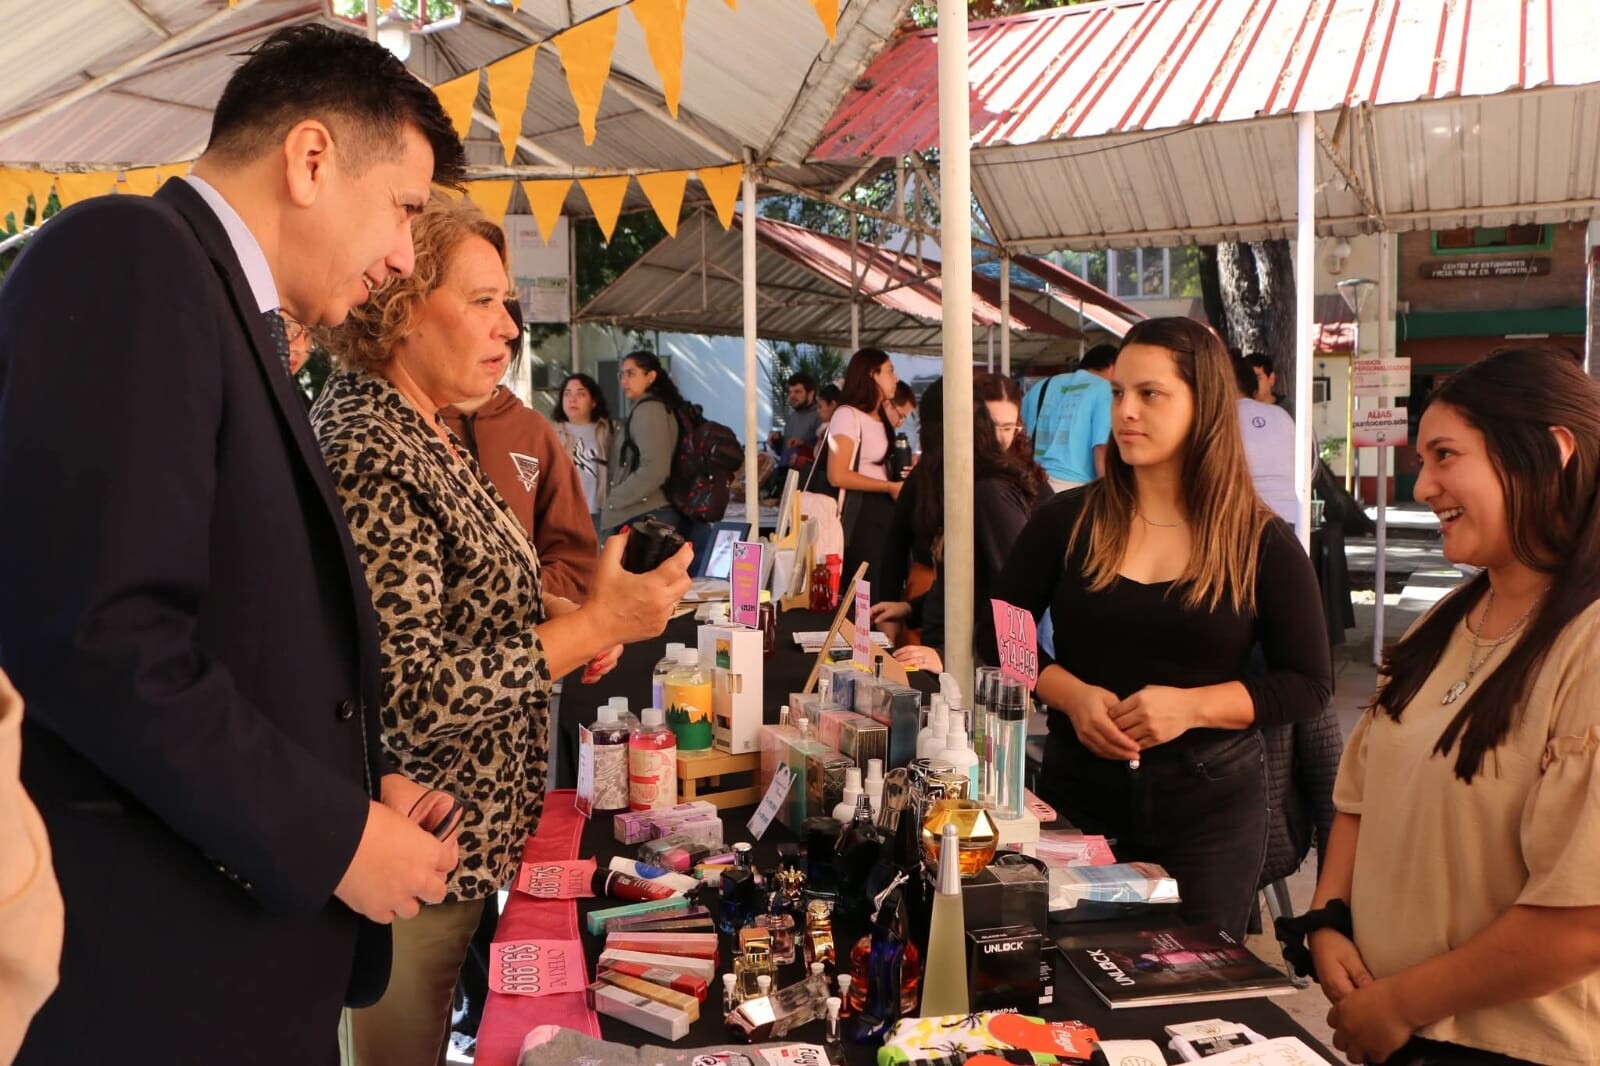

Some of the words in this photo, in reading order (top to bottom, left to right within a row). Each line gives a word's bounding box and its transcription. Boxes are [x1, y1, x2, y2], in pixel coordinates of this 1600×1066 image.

[1367, 410, 1392, 419] ALIAS
[983, 941, 1025, 954] UNLOCK
[499, 943, 541, 993] $9.999
[1086, 949, 1136, 987] UNLOCK
